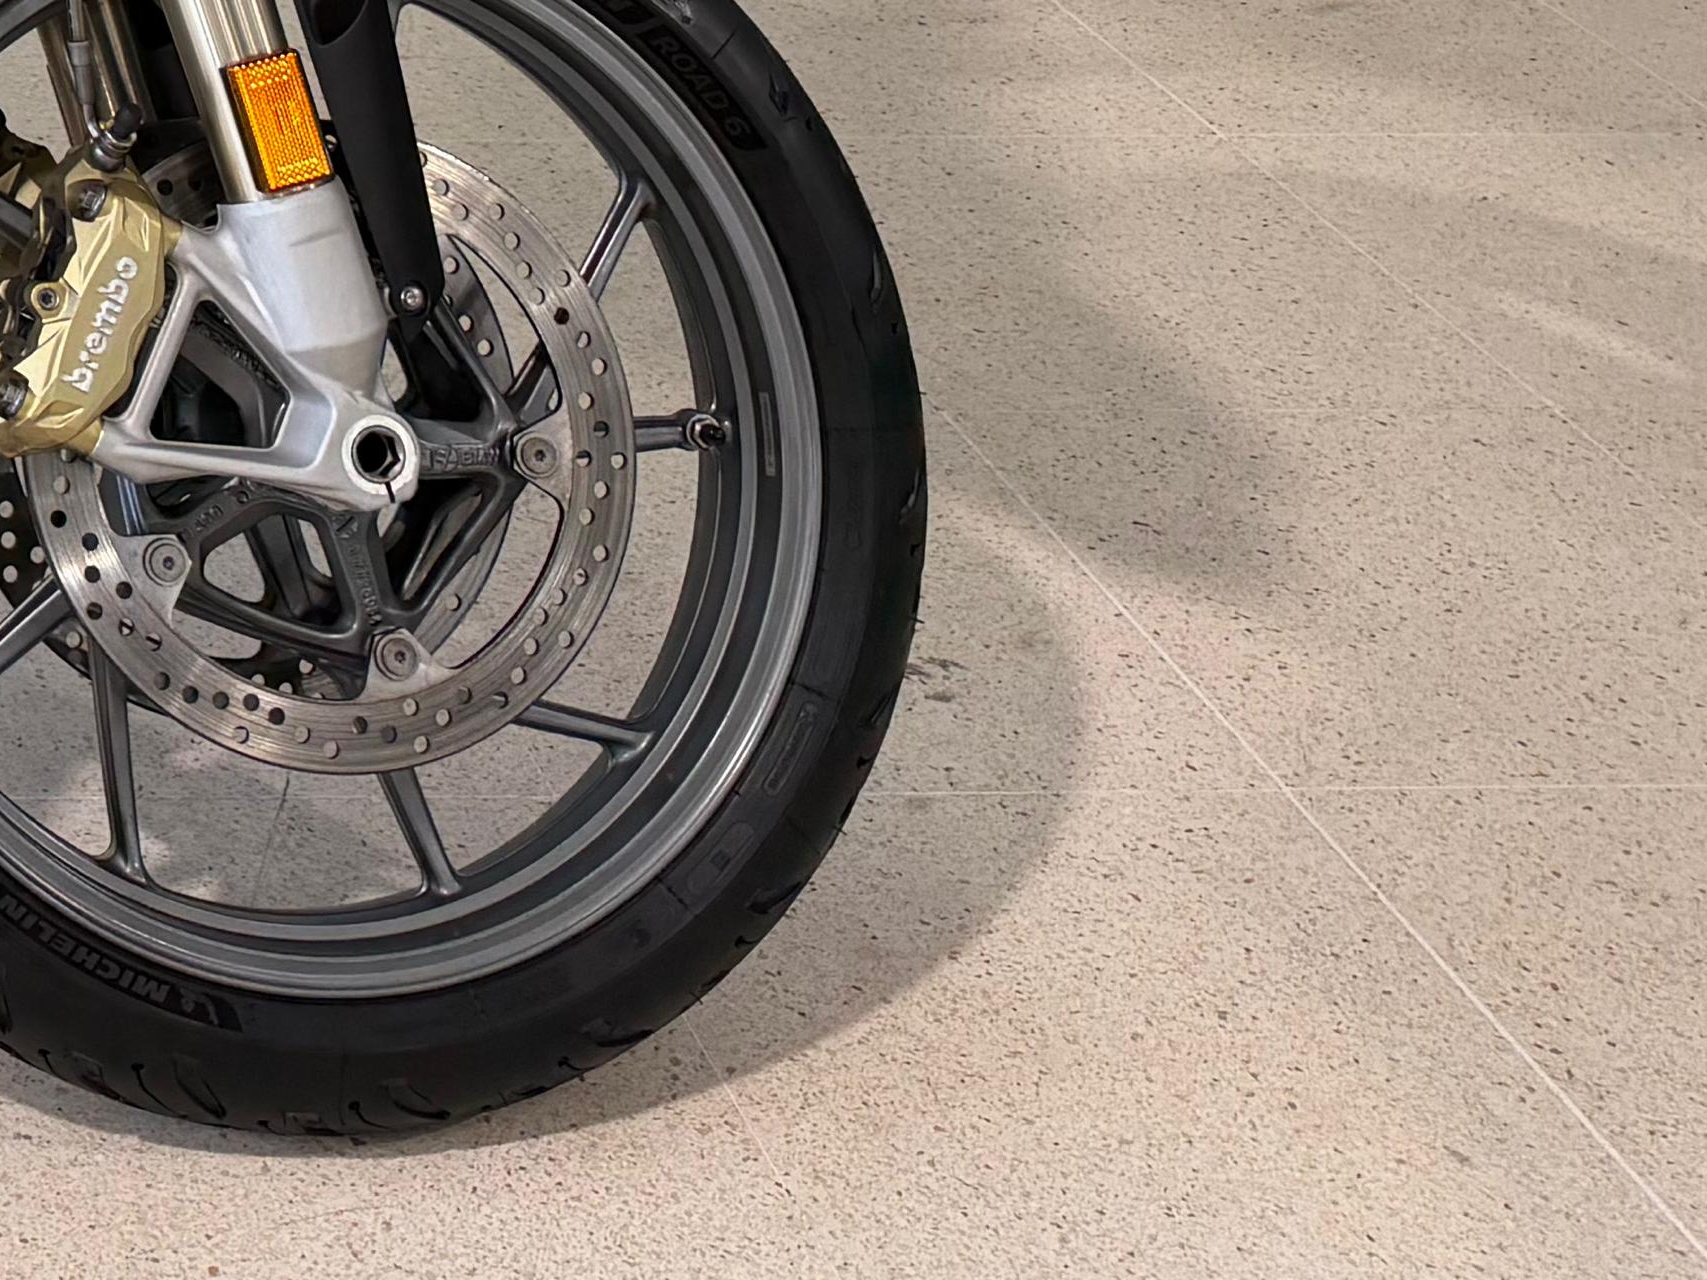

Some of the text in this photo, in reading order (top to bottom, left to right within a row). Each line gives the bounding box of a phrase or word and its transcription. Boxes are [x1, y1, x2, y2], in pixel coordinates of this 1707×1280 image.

[649, 31, 751, 138] ROAD 6
[59, 256, 138, 393] brembo
